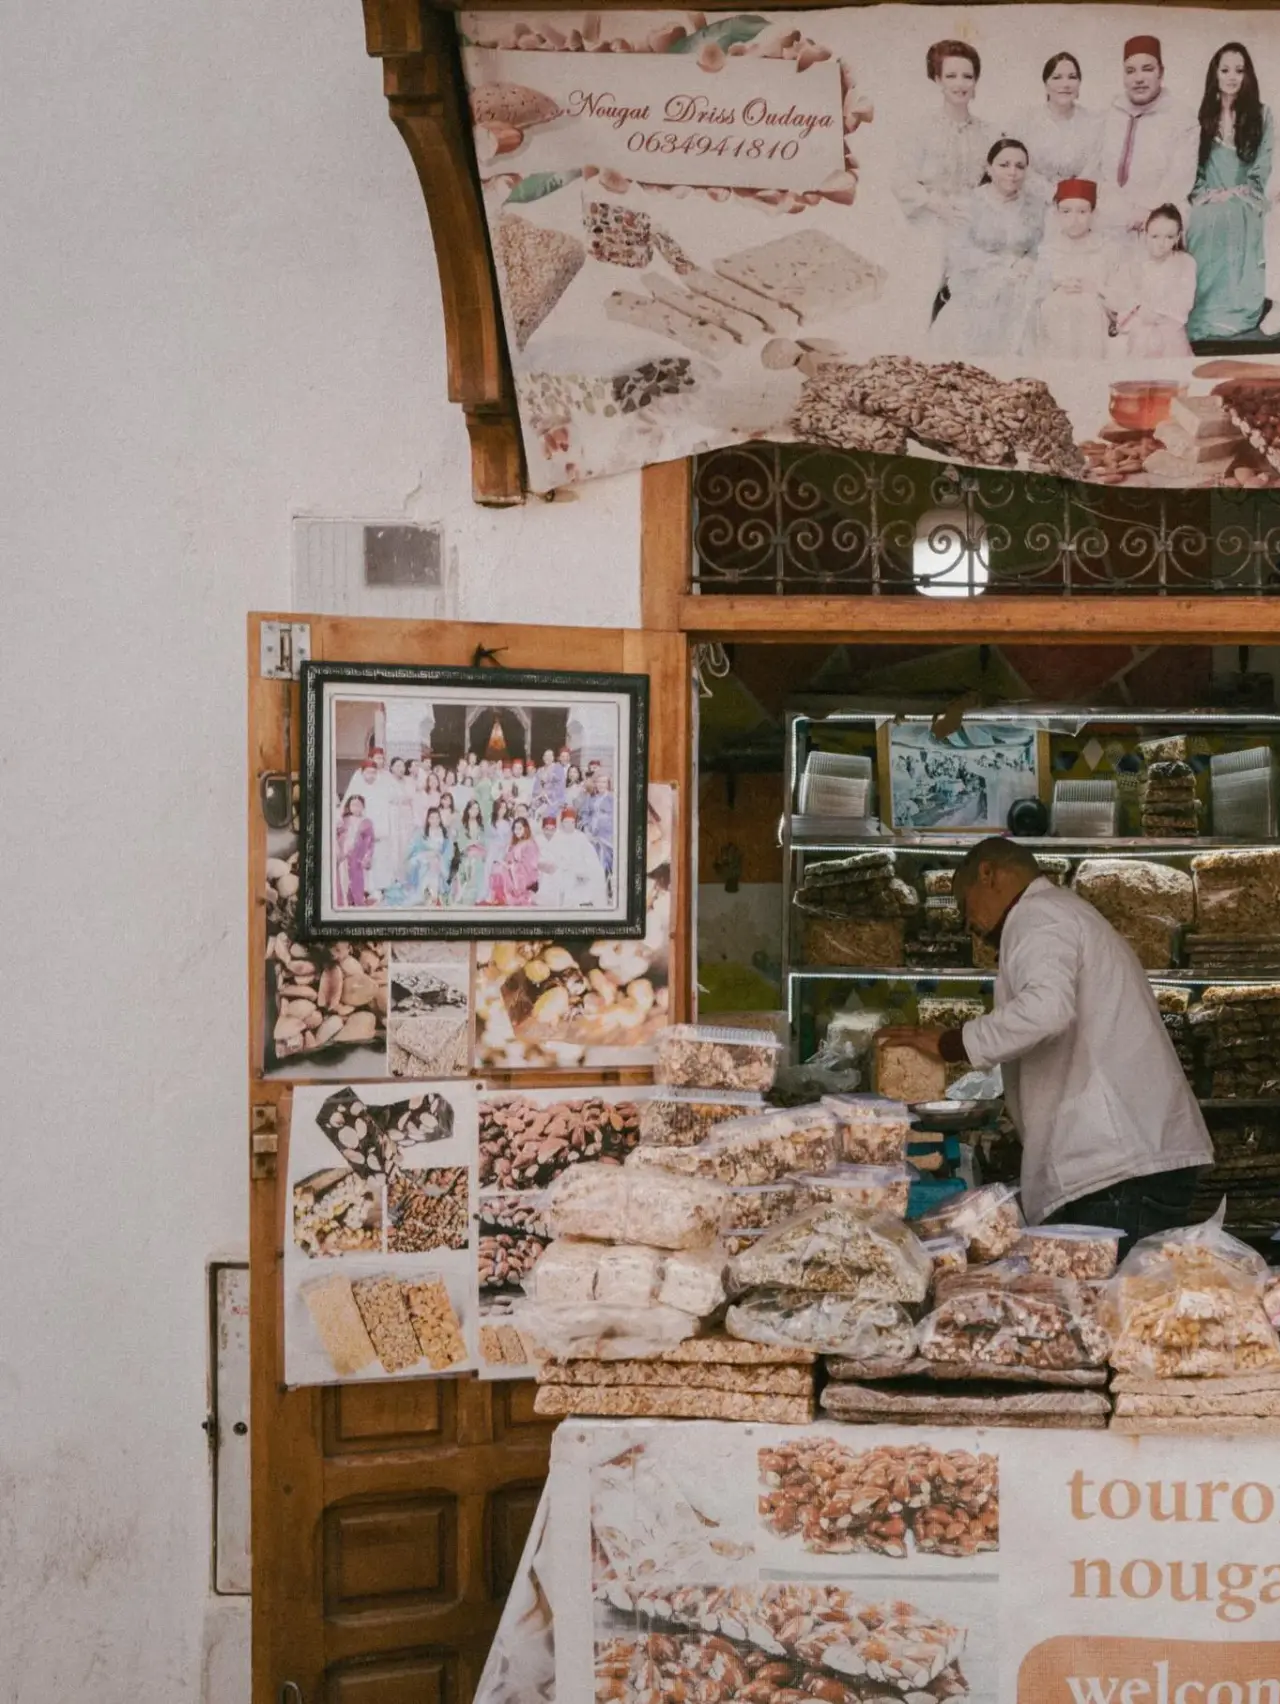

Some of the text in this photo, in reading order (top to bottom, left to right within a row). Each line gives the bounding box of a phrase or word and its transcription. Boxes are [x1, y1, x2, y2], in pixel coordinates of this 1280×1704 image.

[567, 89, 835, 139] Nougat Driss Oudaya
[627, 131, 799, 161] 0634941810
